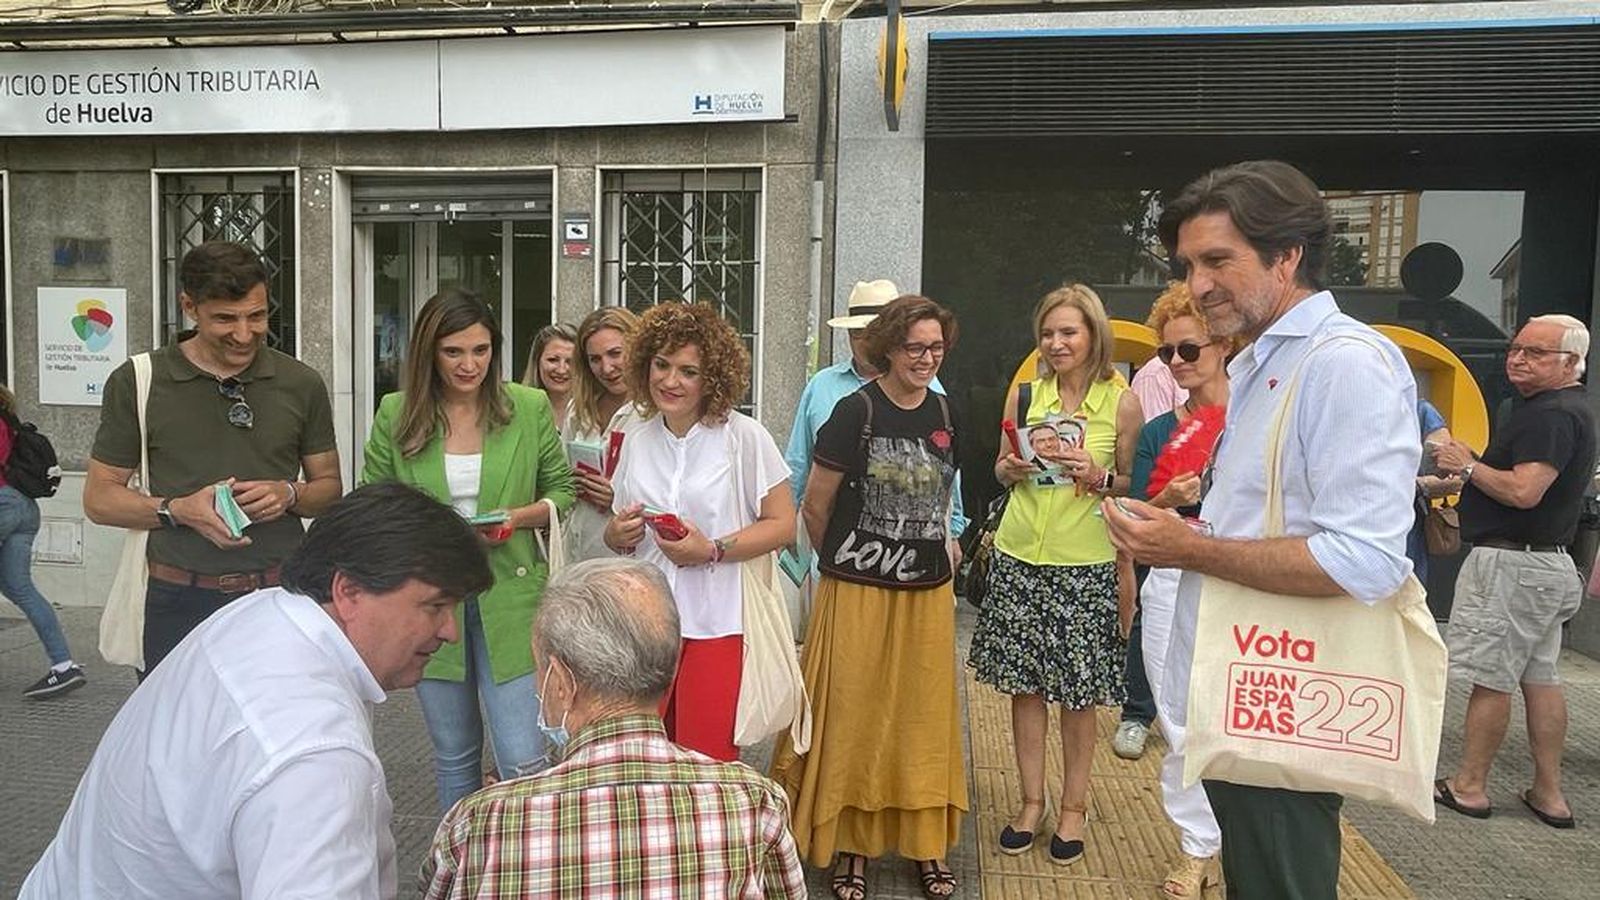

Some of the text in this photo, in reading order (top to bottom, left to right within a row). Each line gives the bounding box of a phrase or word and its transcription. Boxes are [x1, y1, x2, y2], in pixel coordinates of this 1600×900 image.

[52, 74, 81, 96] DE
[87, 66, 180, 95] GESTIÓN
[187, 69, 320, 92] TRIBUTARIA
[46, 102, 153, 124] de Huelva
[1233, 624, 1315, 663] Vota
[1235, 670, 1297, 692] JUAN
[1234, 687, 1295, 712] ESPA
[1232, 706, 1296, 736] DAS
[1296, 678, 1394, 753] 22
